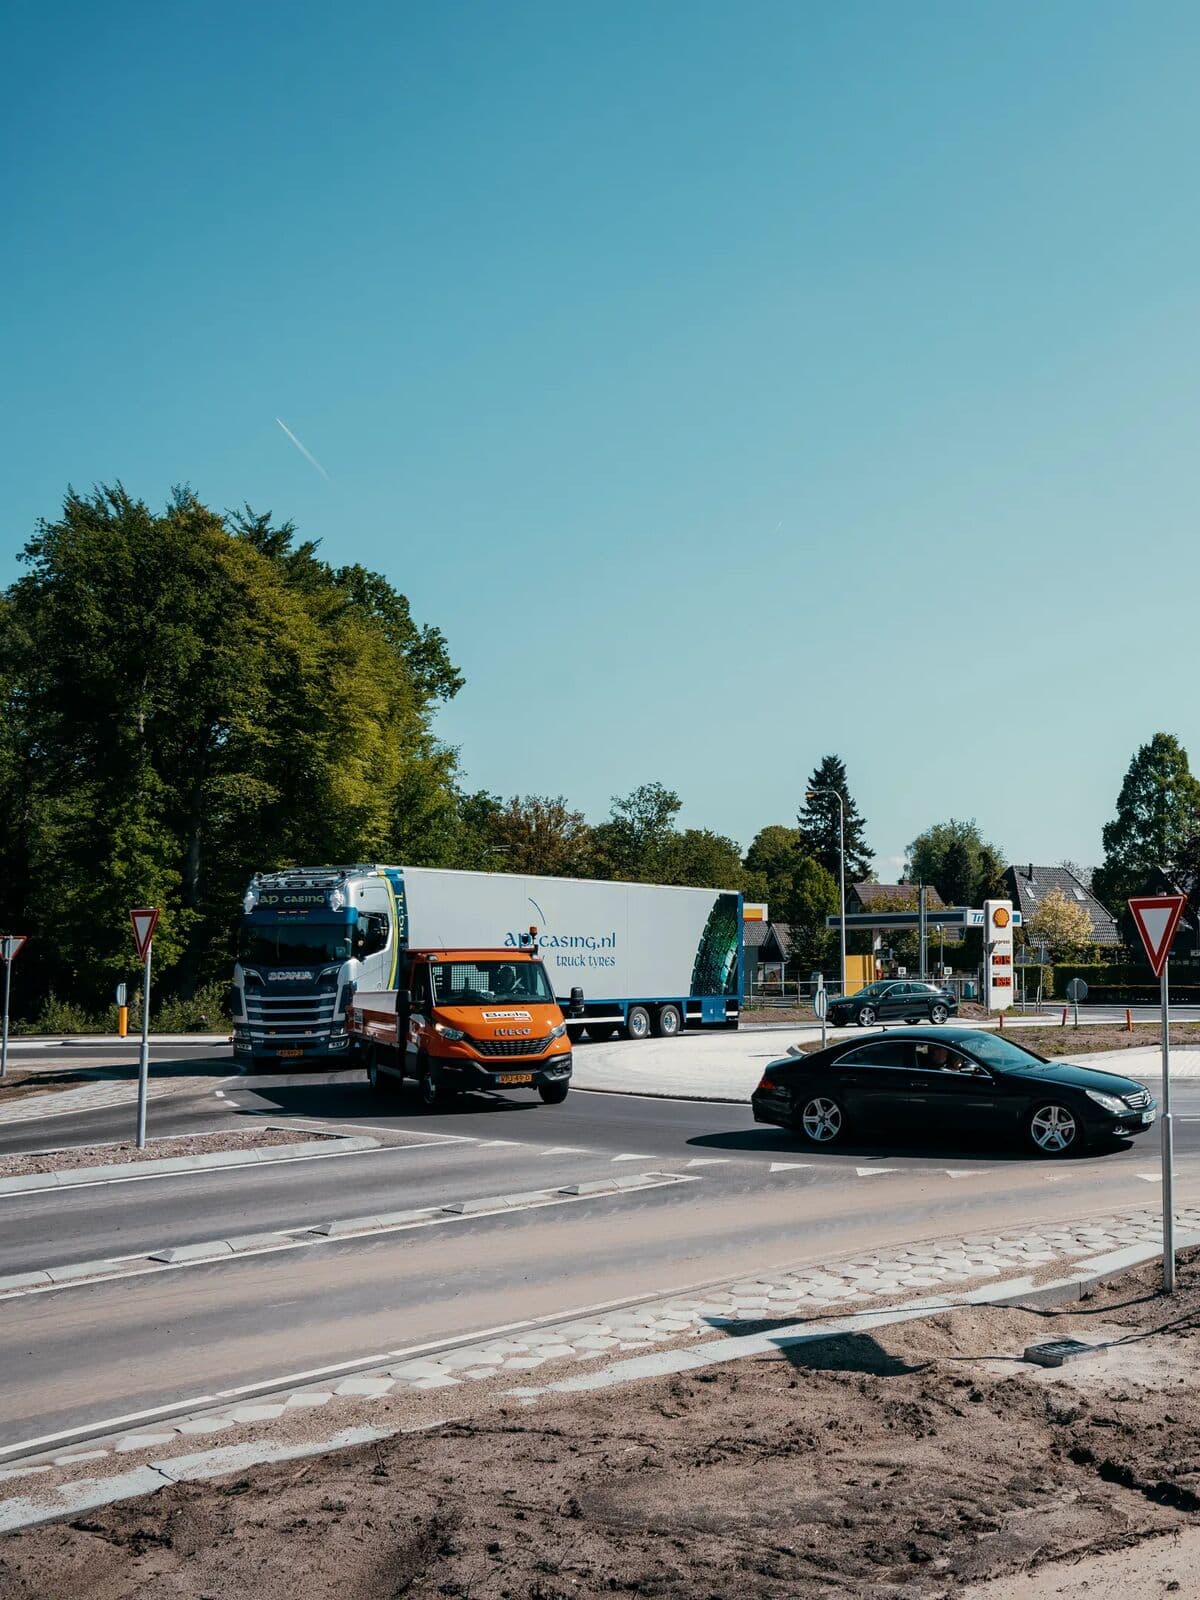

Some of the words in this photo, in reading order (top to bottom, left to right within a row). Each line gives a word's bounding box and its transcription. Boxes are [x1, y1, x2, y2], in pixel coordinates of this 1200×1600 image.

[260, 895, 279, 904] ap
[283, 894, 325, 904] casing
[394, 892, 404, 938] ng.nl
[538, 932, 616, 950] casing.nl
[268, 971, 313, 981] SCANIA
[495, 1028, 530, 1036] IVECO
